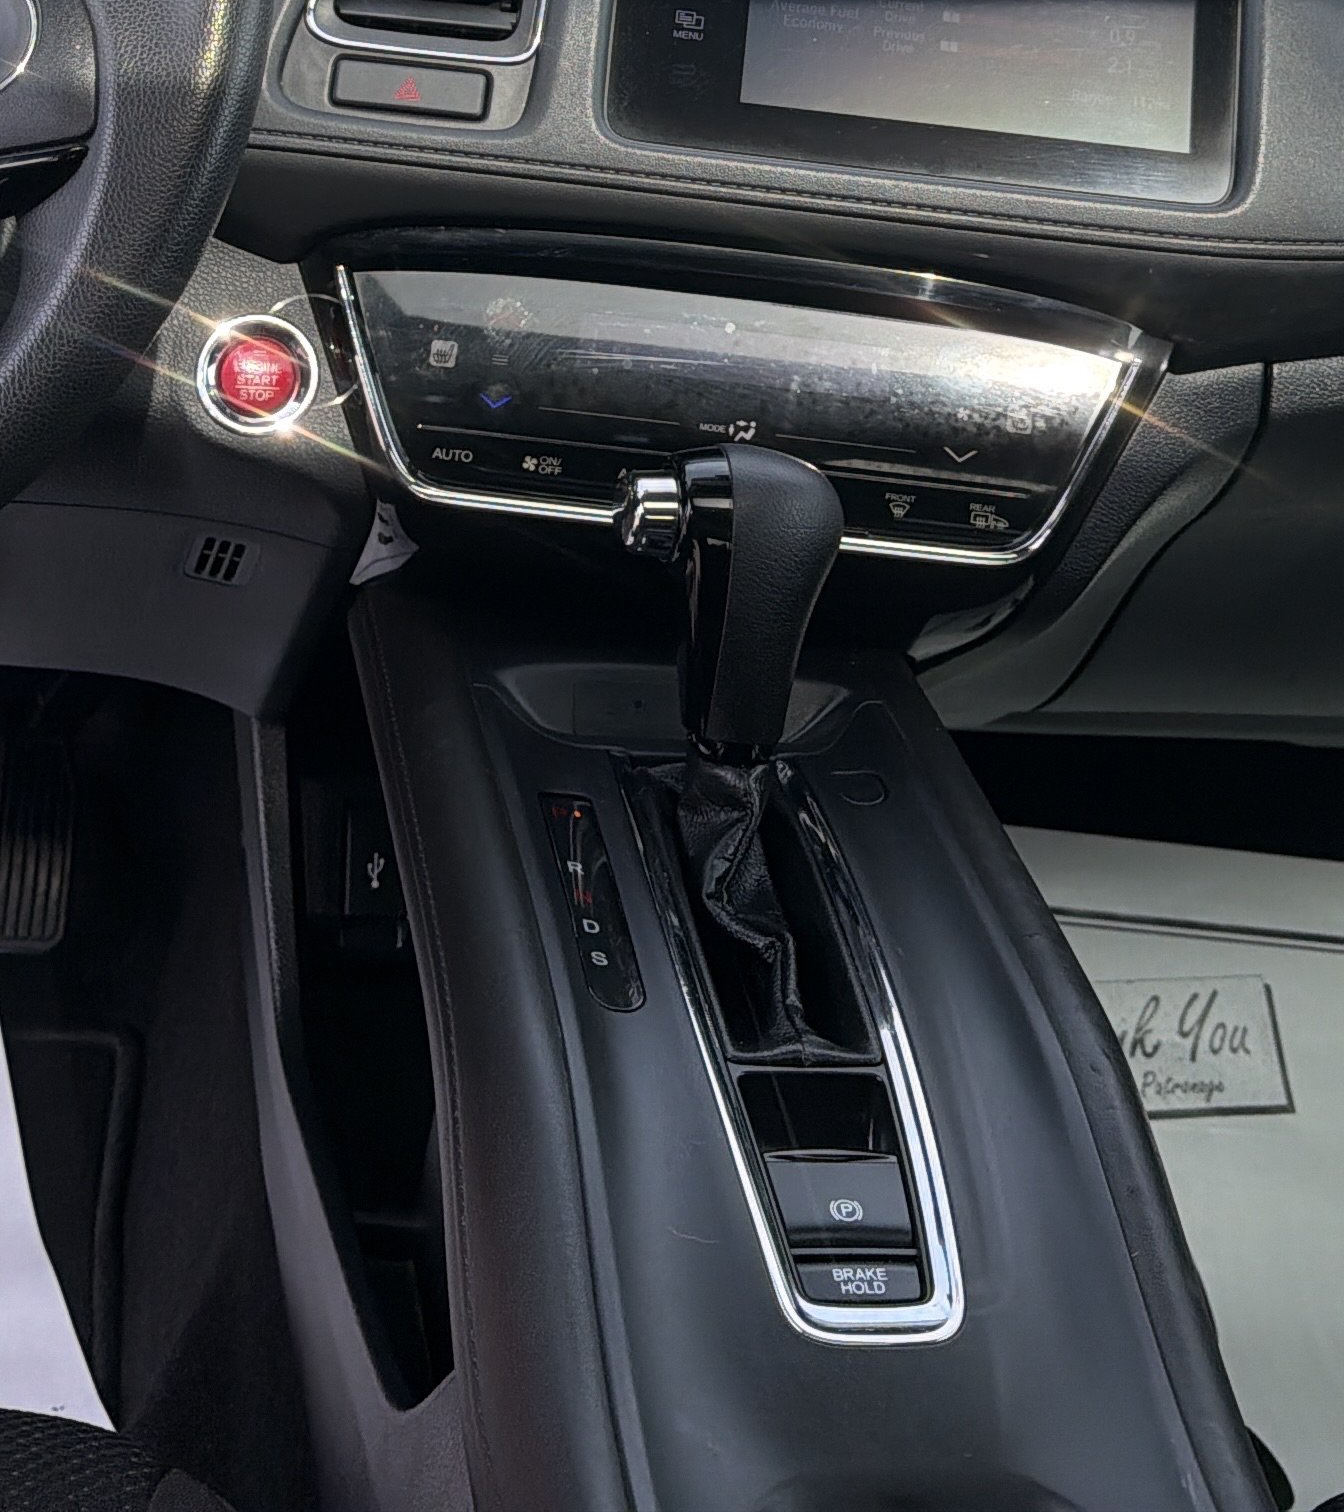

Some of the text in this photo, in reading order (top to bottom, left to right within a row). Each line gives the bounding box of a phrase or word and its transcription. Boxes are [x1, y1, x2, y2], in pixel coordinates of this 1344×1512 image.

[830, 4, 861, 20] Fuel
[884, 9, 916, 24] Drive
[782, 13, 844, 34] Economy
[672, 29, 704, 42] MENU
[873, 26, 926, 42] Previous
[881, 39, 915, 54] Drive
[236, 374, 279, 386] START
[239, 389, 275, 401] STOP
[699, 422, 727, 434] MODE
[432, 448, 474, 464] AUTO
[539, 455, 563, 467] ON/
[538, 464, 563, 476] OFF
[885, 492, 917, 504] FRONT
[969, 503, 996, 513] REAR
[567, 860, 584, 875] R
[582, 918, 600, 934] D
[590, 951, 608, 966] S
[1176, 989, 1251, 1063] You
[832, 1268, 888, 1281] BRAKE
[840, 1281, 886, 1295] HOLD
